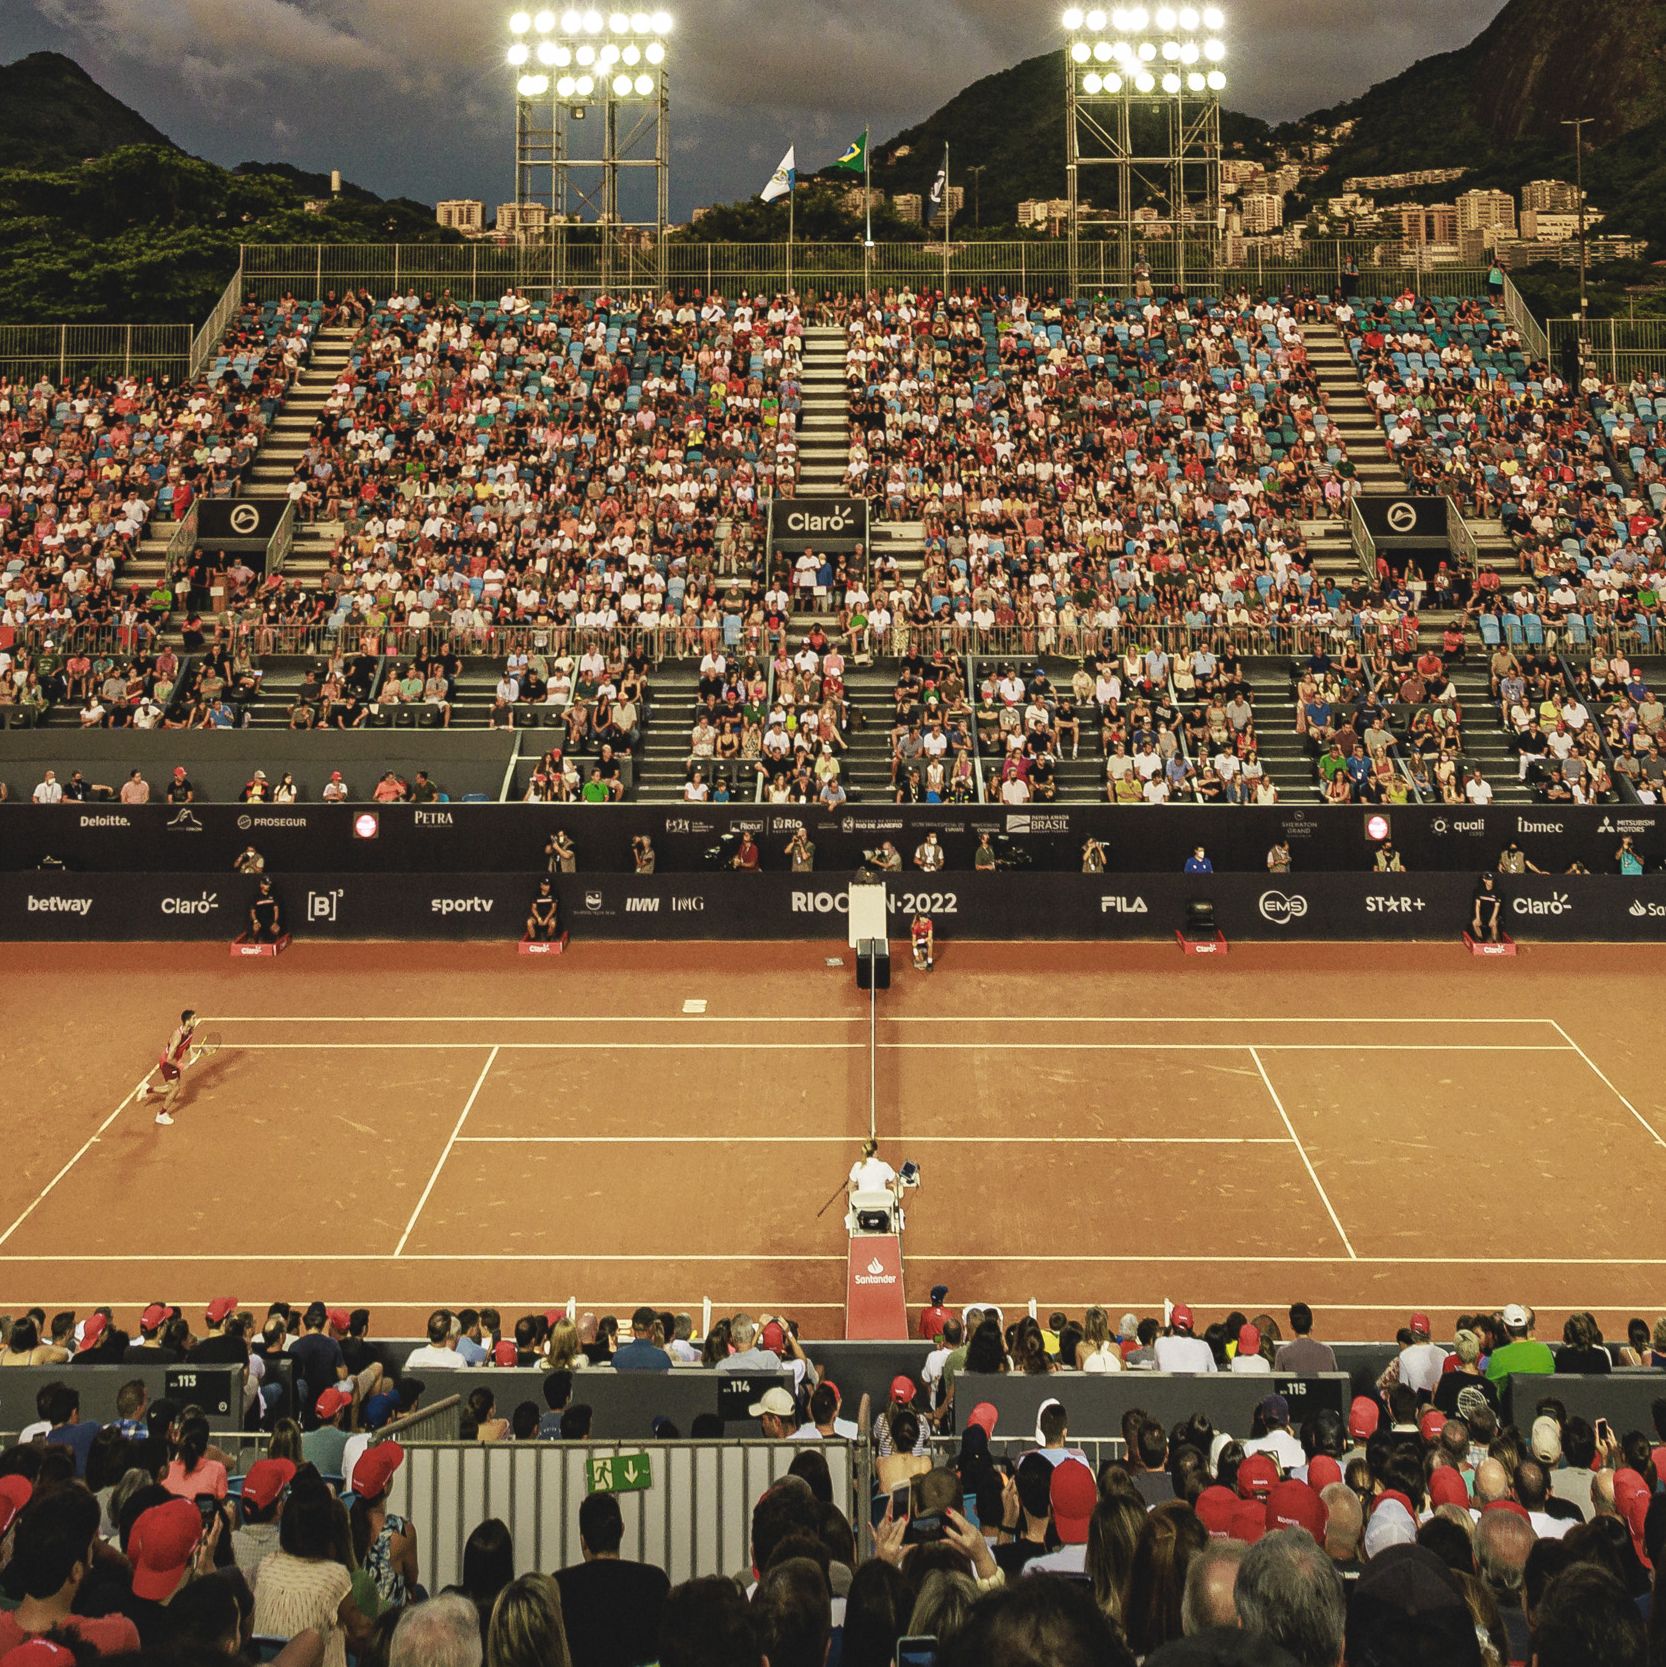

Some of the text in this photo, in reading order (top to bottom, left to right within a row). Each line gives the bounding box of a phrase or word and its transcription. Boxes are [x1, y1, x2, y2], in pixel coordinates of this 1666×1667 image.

[787, 513, 844, 531] Claro
[80, 815, 131, 827] Deloitte.
[253, 817, 307, 828] PROSEGUR
[784, 818, 803, 829] Rio
[1031, 820, 1069, 830] BRASIL
[1453, 818, 1485, 832] quali
[1617, 819, 1656, 827] MITSUBISHI
[27, 894, 93, 915] betway
[160, 897, 211, 915] Claro
[431, 896, 494, 915] sportv
[625, 897, 661, 912] IMM
[672, 896, 704, 912] IMG
[1101, 895, 1148, 913] FILA
[1264, 900, 1303, 913] EMS
[1513, 897, 1561, 916] Claro
[241, 946, 259, 955] Claro
[529, 943, 547, 953] Claro
[1196, 944, 1214, 953] Claro
[1483, 945, 1501, 954] Claro
[854, 1274, 897, 1285] Santander
[178, 1375, 197, 1387] 113
[730, 1380, 750, 1392] 114
[1286, 1383, 1307, 1395] 115
